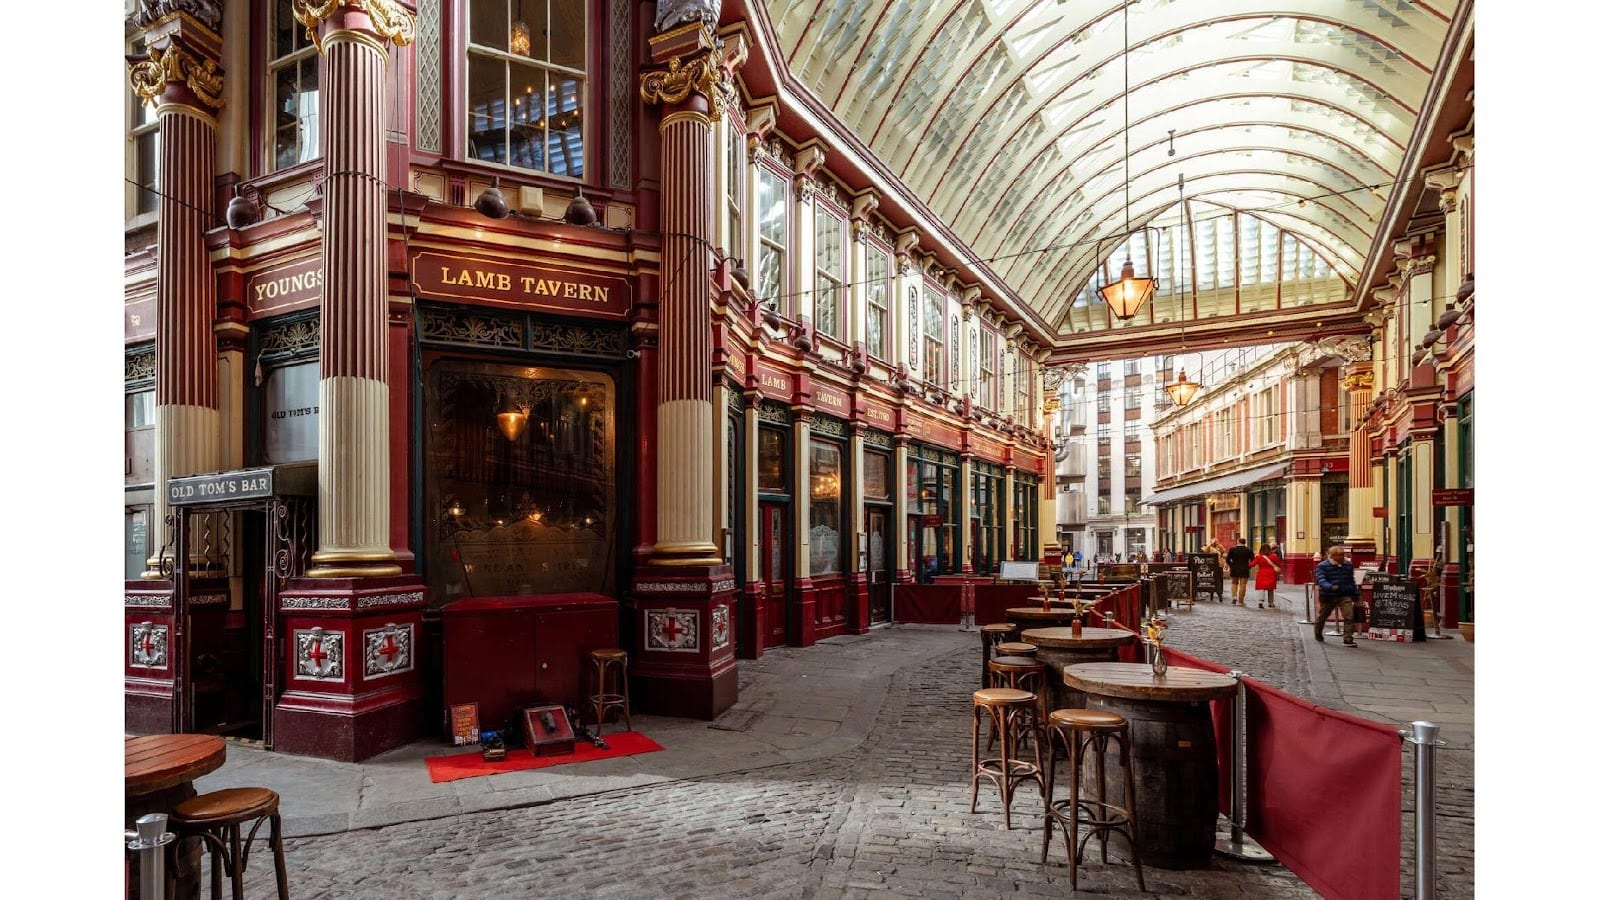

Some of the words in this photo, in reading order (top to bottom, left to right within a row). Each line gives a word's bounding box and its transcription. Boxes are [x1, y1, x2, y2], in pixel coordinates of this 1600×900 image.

[441, 266, 512, 292] LAMB
[520, 276, 610, 303] TAVERN
[761, 373, 787, 391] LAMB
[816, 391, 843, 408] TAVERN
[271, 410, 287, 419] OLD
[171, 484, 195, 498] OLD
[198, 480, 238, 496] TOM'S
[241, 477, 268, 492] BAR
